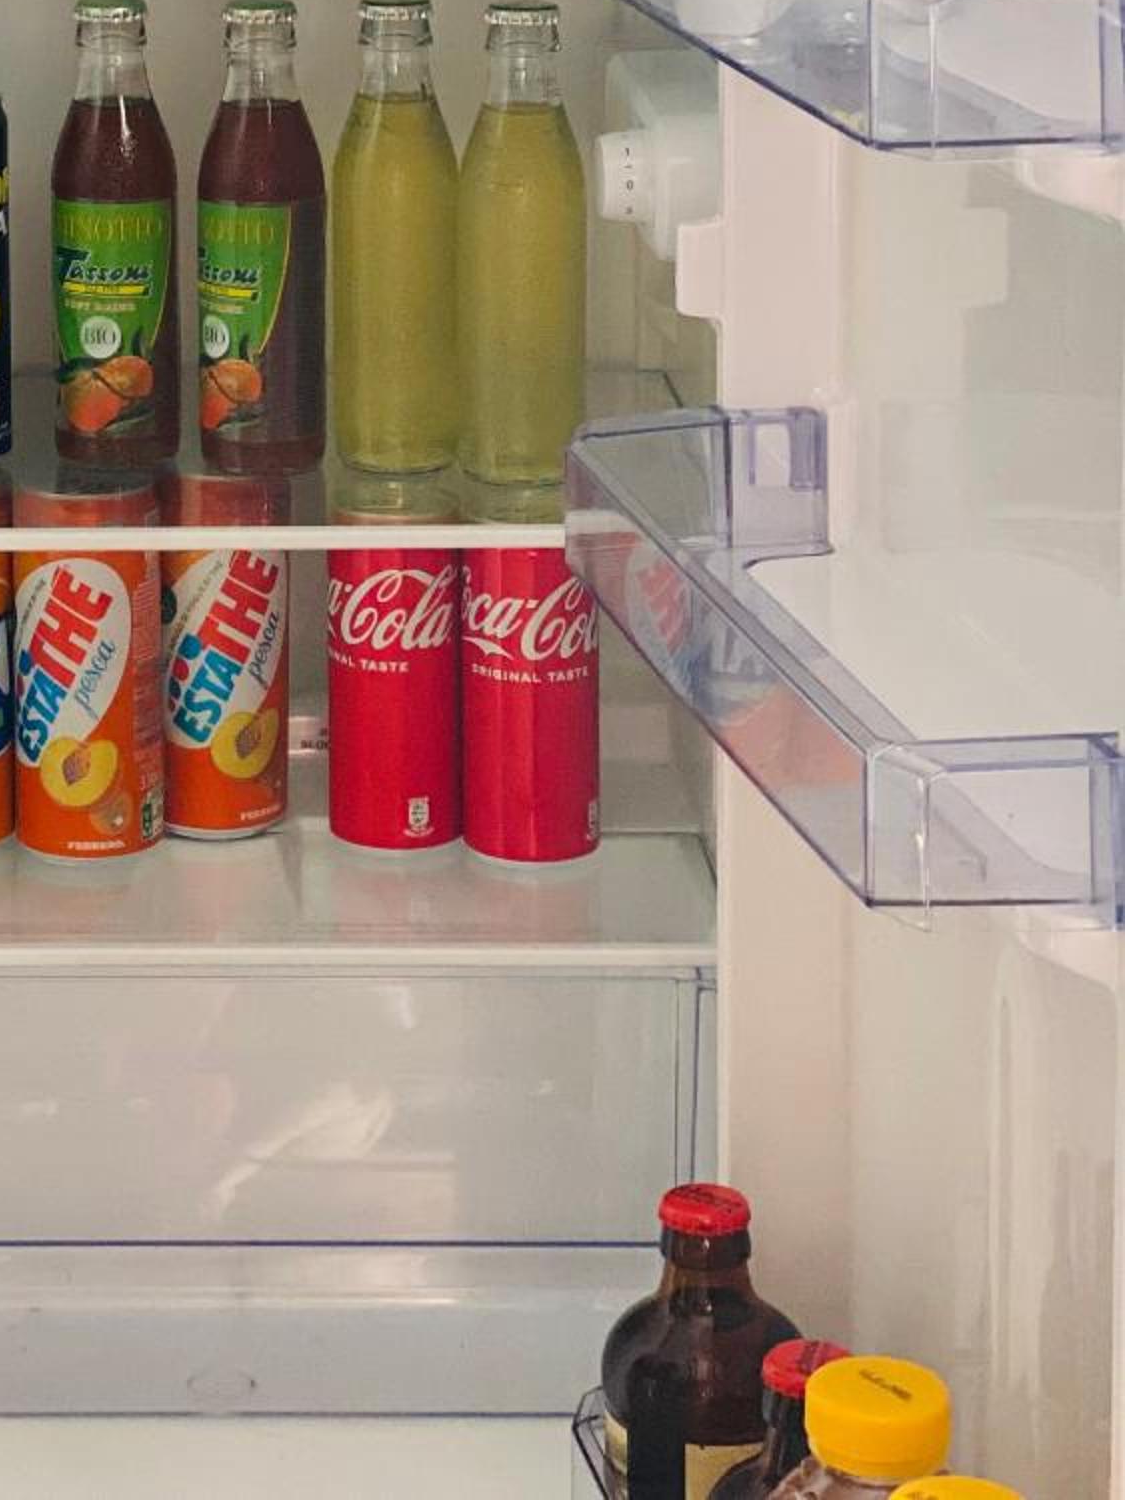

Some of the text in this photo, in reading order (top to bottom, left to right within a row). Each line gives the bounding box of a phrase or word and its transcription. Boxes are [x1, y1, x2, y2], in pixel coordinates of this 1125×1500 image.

[246, 611, 280, 691] pesca
[360, 659, 410, 673] TASTE
[472, 663, 589, 683] ORIGINAL TASTE
[74, 640, 115, 720] pesca
